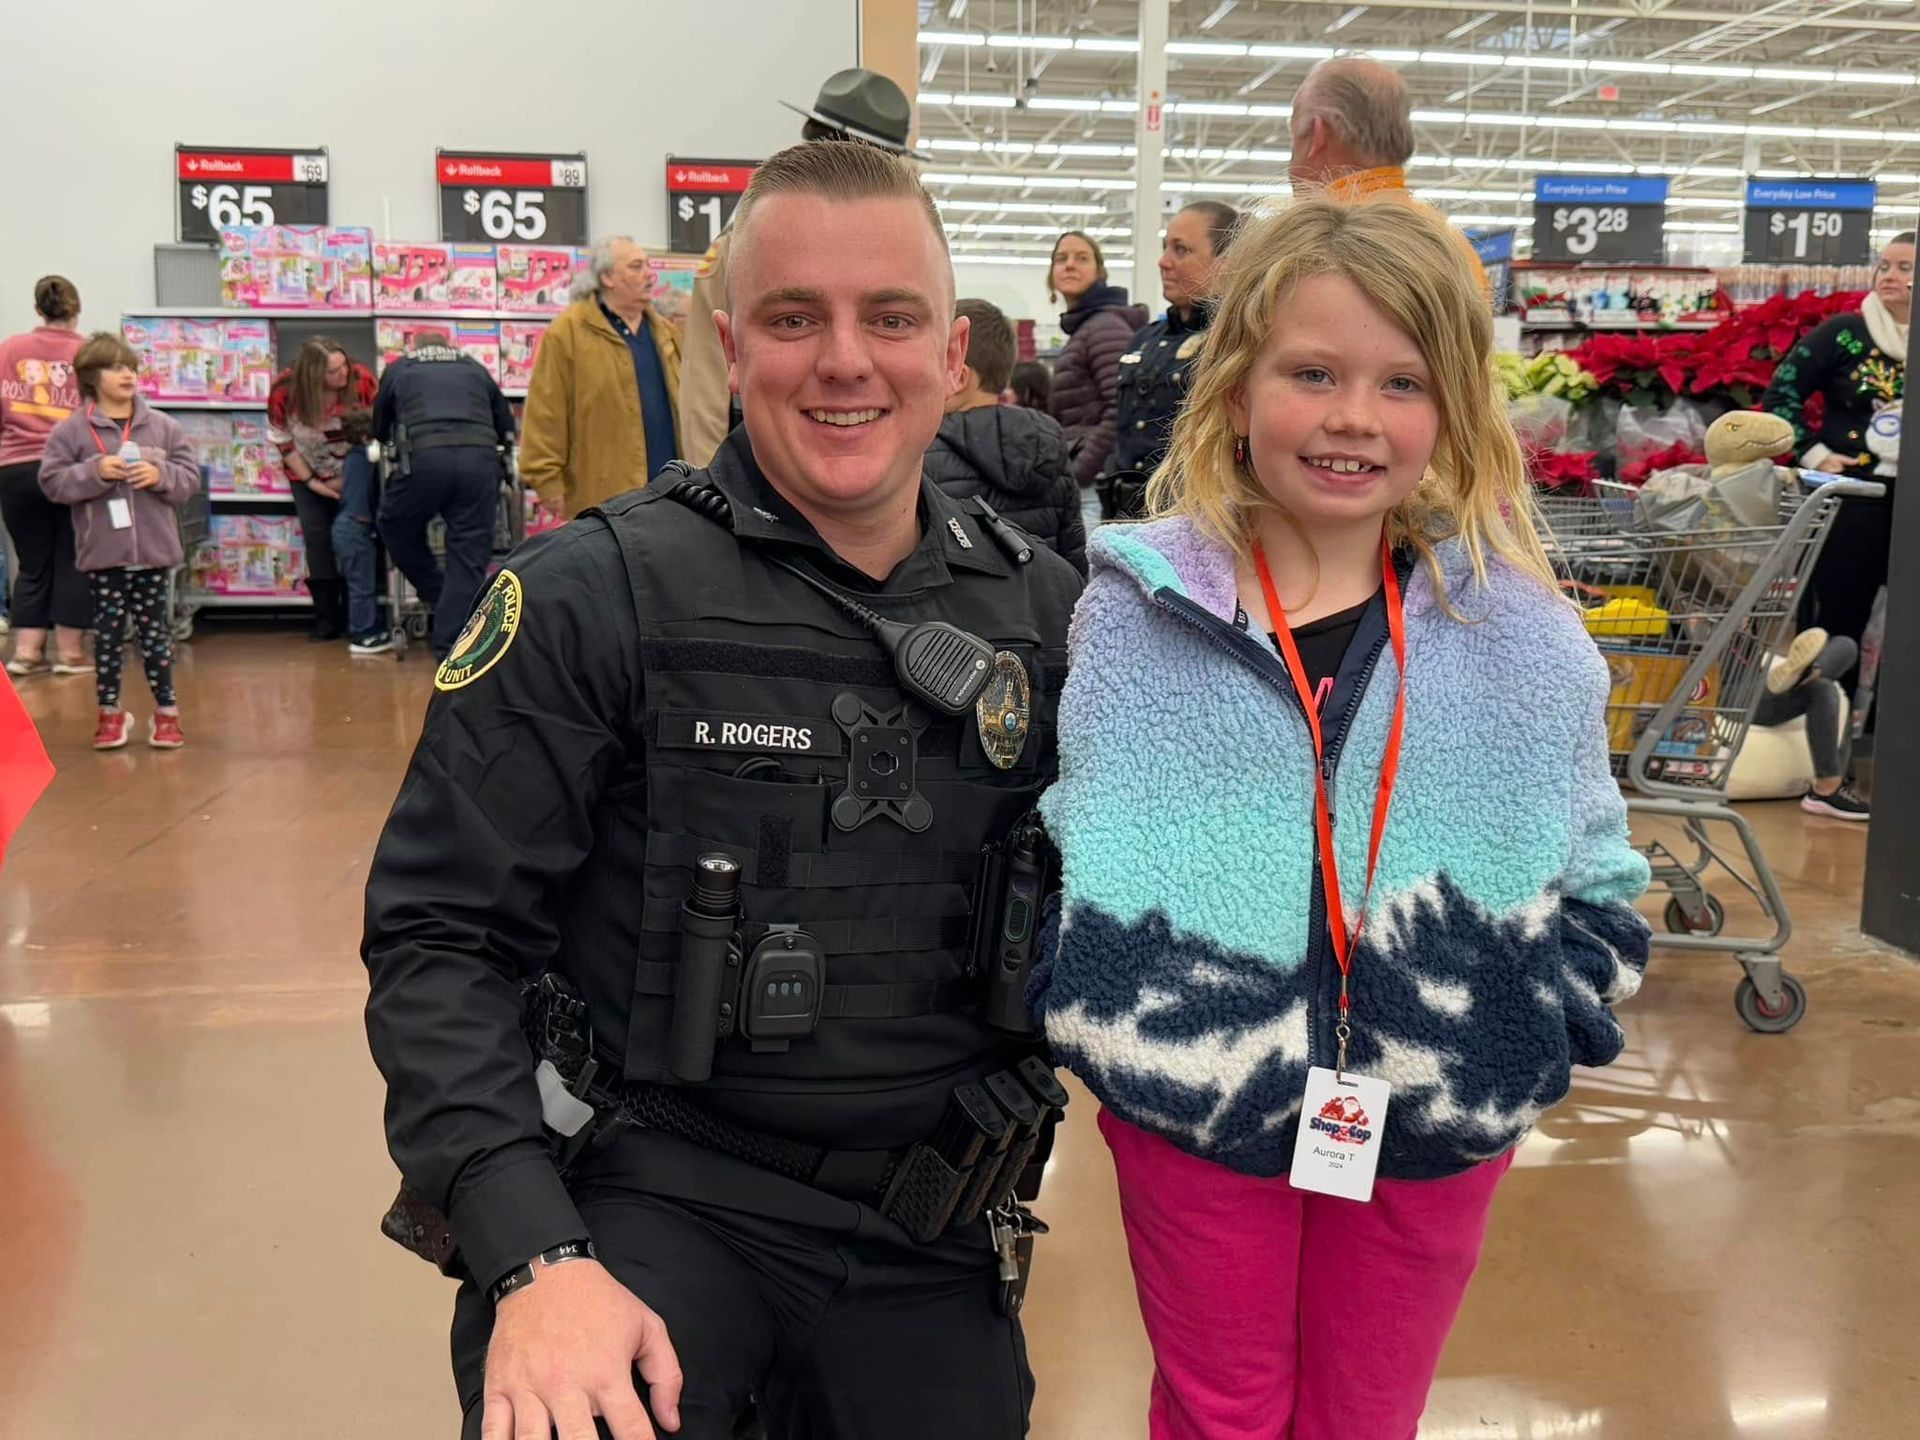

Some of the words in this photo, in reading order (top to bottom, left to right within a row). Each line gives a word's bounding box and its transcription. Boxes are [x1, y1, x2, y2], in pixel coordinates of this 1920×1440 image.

[200, 159, 244, 172] Rollback
[458, 164, 502, 177] Rollback
[687, 170, 730, 184] Rollback
[1543, 183, 1585, 196] Everyday
[1585, 184, 1604, 195] Low
[1605, 184, 1629, 195] Price
[1753, 187, 1793, 200] Everyday
[1795, 188, 1812, 199] Low
[1813, 189, 1836, 200] Price
[191, 183, 275, 231] $65
[463, 188, 547, 241] $65
[501, 584, 516, 633] POLICE
[445, 664, 473, 683] UNIT
[954, 669, 977, 701] MOTOROLA
[695, 721, 716, 744] R.
[721, 722, 812, 750] ROGERS
[1309, 1117, 1341, 1138] Shop
[1349, 1125, 1372, 1142] Cop
[1313, 1146, 1346, 1161] Aurora
[1348, 1153, 1355, 1162] T
[1328, 1161, 1343, 1169] 2024
